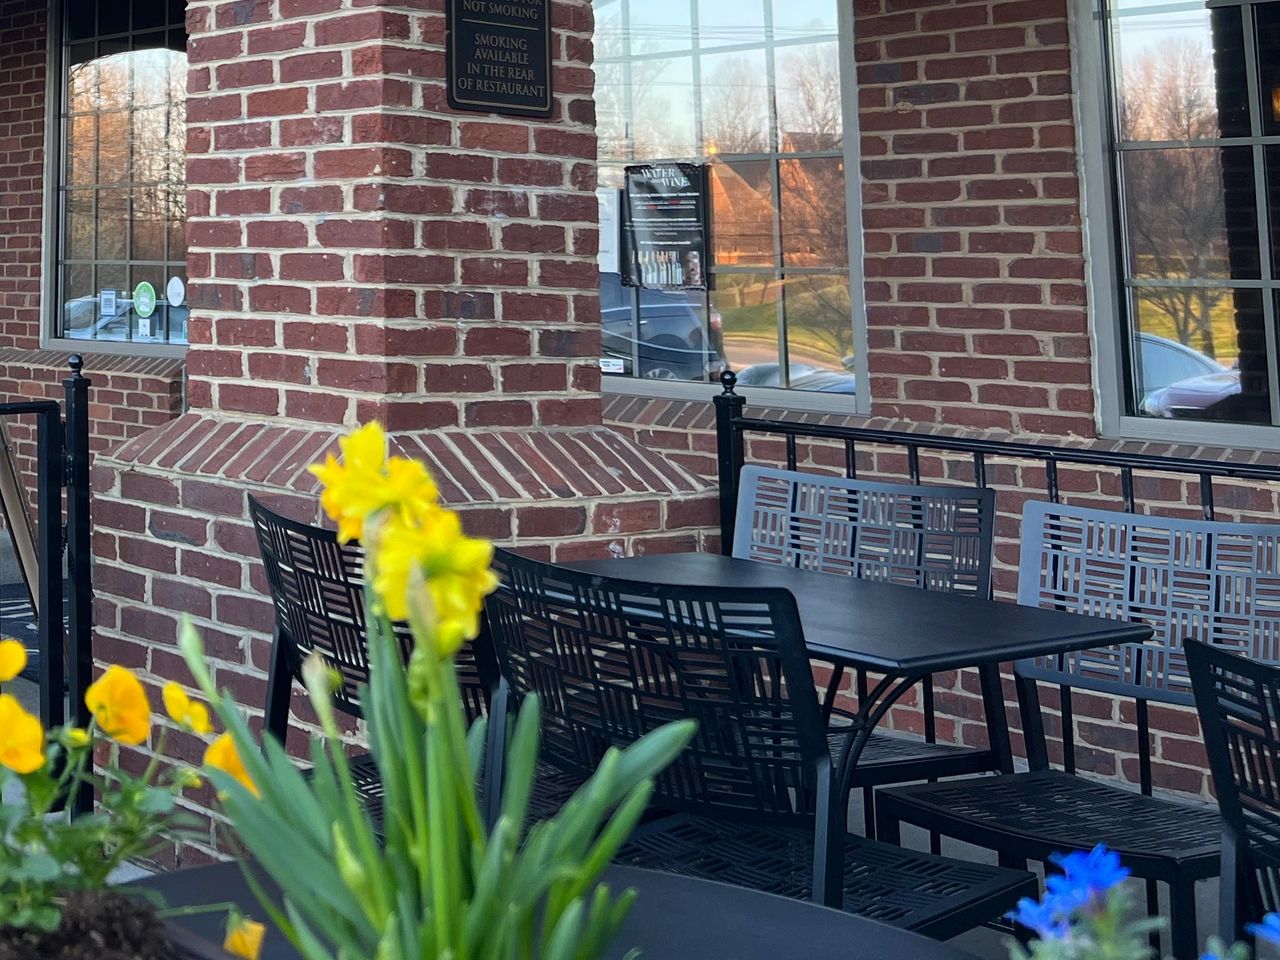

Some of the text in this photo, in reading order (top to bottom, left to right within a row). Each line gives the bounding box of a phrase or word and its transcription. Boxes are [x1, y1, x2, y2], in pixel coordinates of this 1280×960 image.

[463, 0, 538, 20] NOT SMOKING
[474, 33, 527, 51] SMOKING
[474, 48, 529, 65] AVAILABLE
[467, 62, 535, 81] IN THE REAR
[457, 77, 545, 98] OF RESTAURANT
[641, 167, 675, 178] WATER
